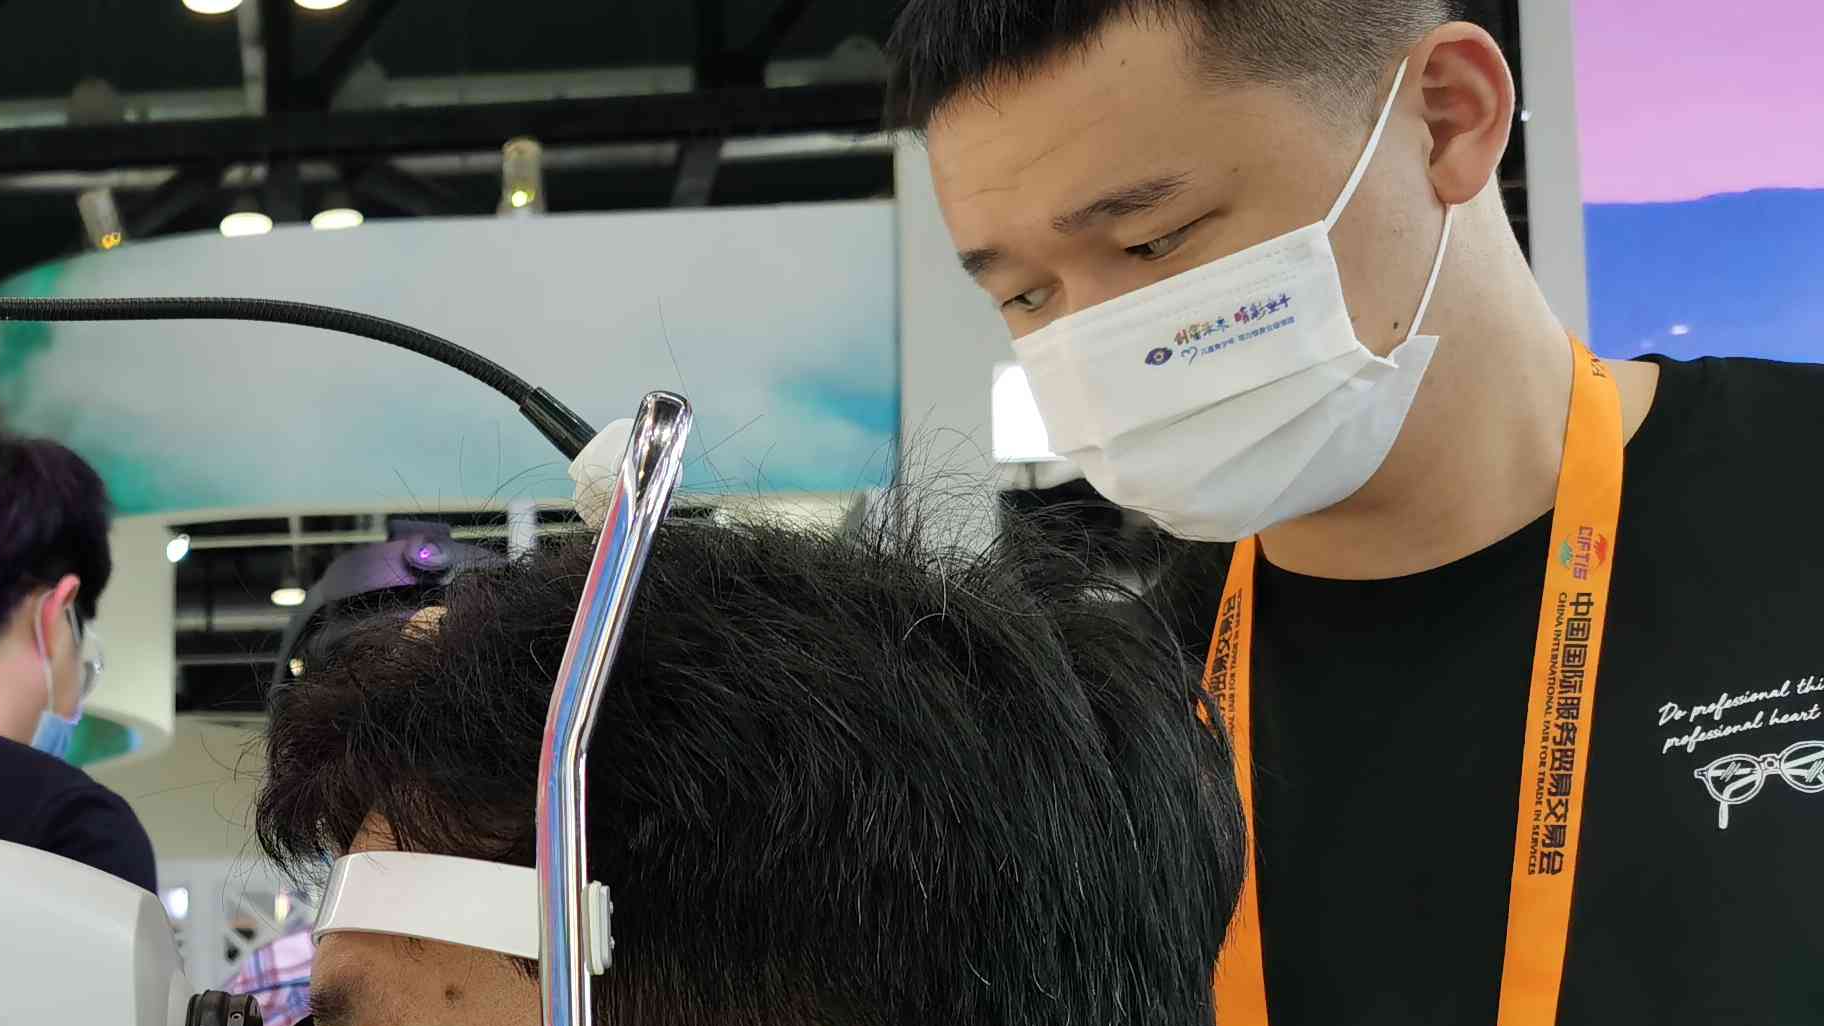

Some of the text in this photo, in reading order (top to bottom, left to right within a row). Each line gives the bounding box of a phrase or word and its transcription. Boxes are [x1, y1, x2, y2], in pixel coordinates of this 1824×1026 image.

[1659, 702, 1687, 726] Do
[1689, 679, 1791, 722] professional
[1538, 592, 1594, 876] 中国国际服务贸易交易会
[1662, 703, 1822, 754] professional heart
